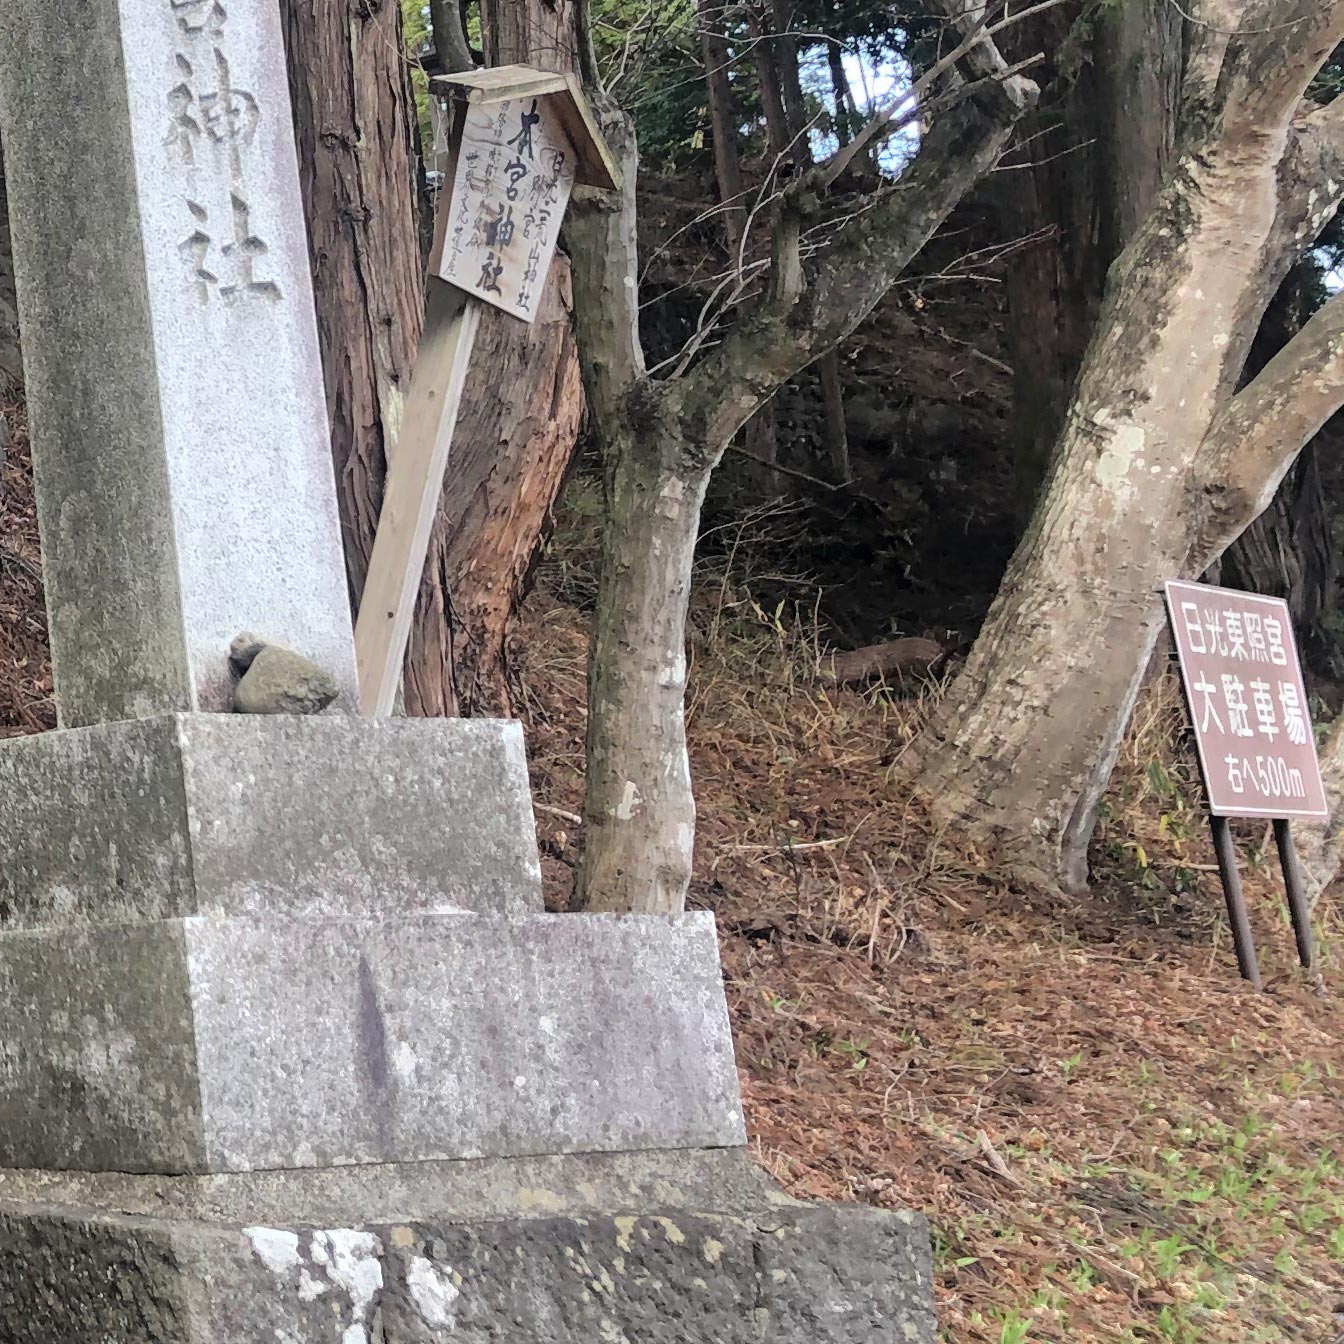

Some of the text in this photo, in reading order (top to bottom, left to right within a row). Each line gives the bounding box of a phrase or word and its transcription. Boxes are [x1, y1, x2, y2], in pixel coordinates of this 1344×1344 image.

[475, 98, 541, 297] 本宮神社
[1181, 602, 1288, 666] 日光東照宮
[1193, 670, 1307, 745] 大駐車場
[1225, 752, 1305, 798] 右へ500m
